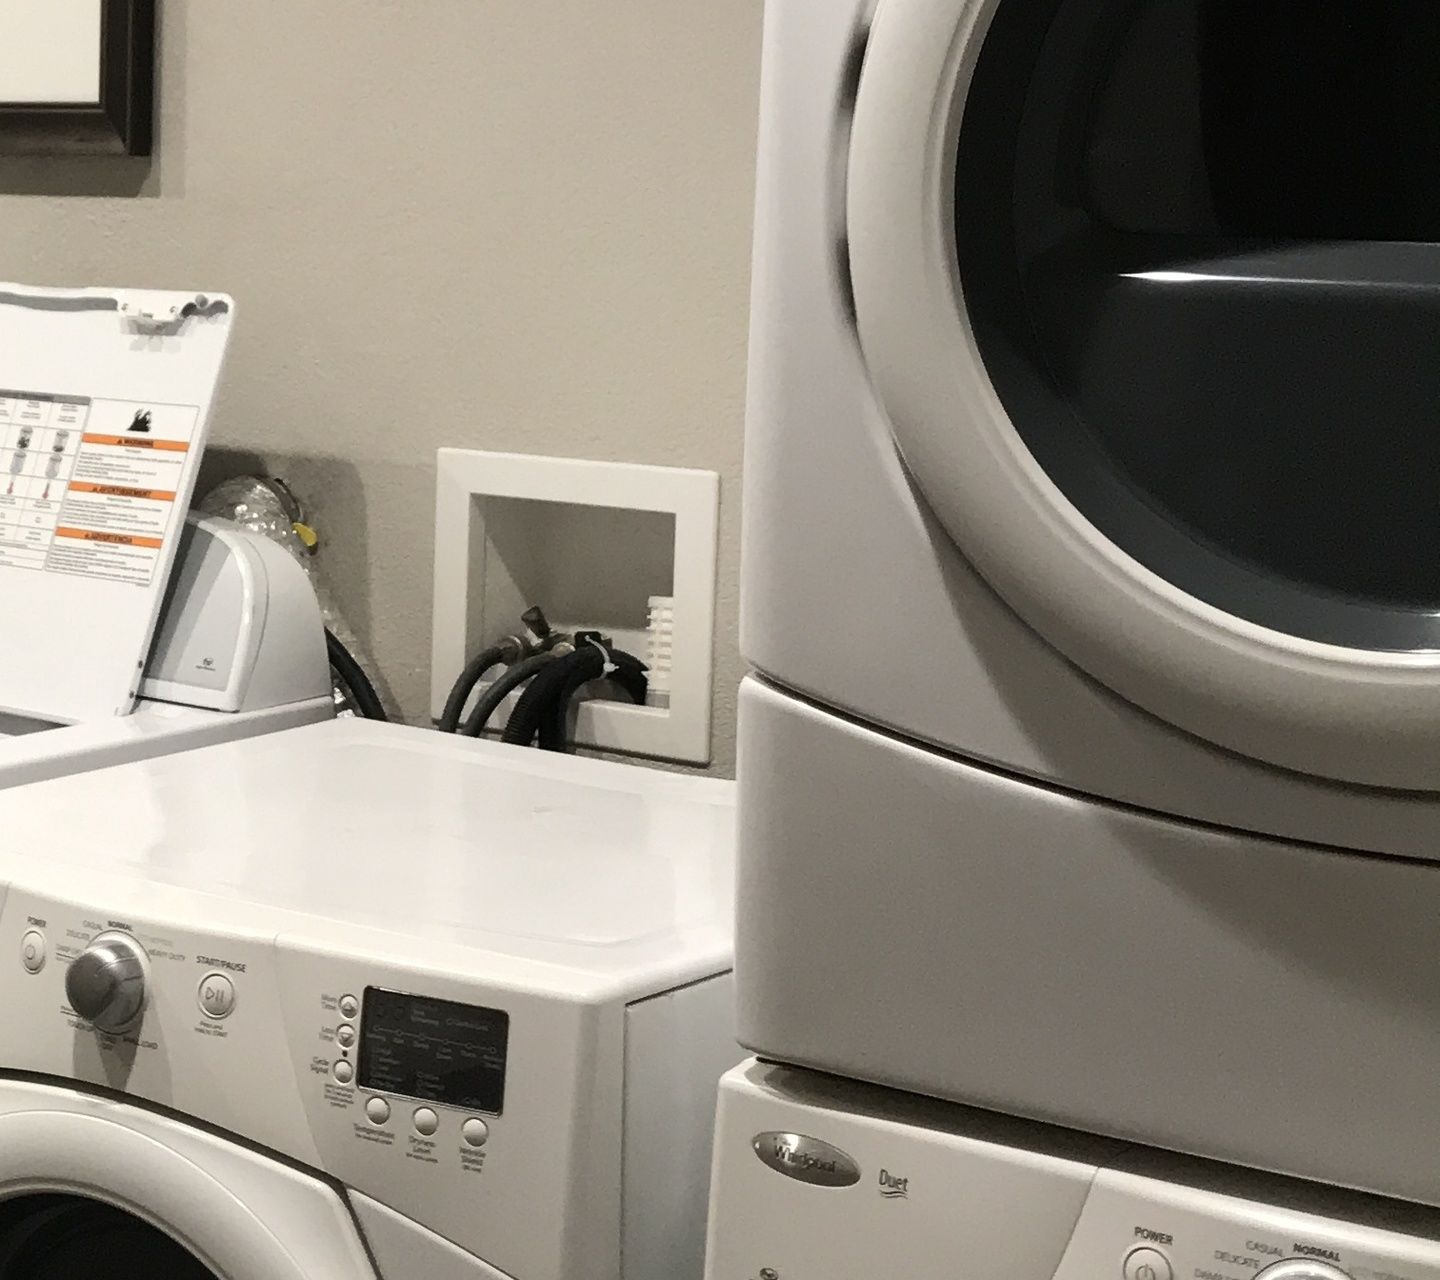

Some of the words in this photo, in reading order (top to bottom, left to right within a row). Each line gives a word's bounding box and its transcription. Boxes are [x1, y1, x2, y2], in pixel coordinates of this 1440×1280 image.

[196, 955, 247, 974] START/PAUSE
[774, 1146, 836, 1173] Whirlpool
[878, 1169, 909, 1192] Duet
[1134, 1226, 1174, 1246] POWER
[1214, 1249, 1261, 1269] DELICATE
[1245, 1240, 1284, 1258] CASUAL
[1293, 1243, 1342, 1263] NORMAL
